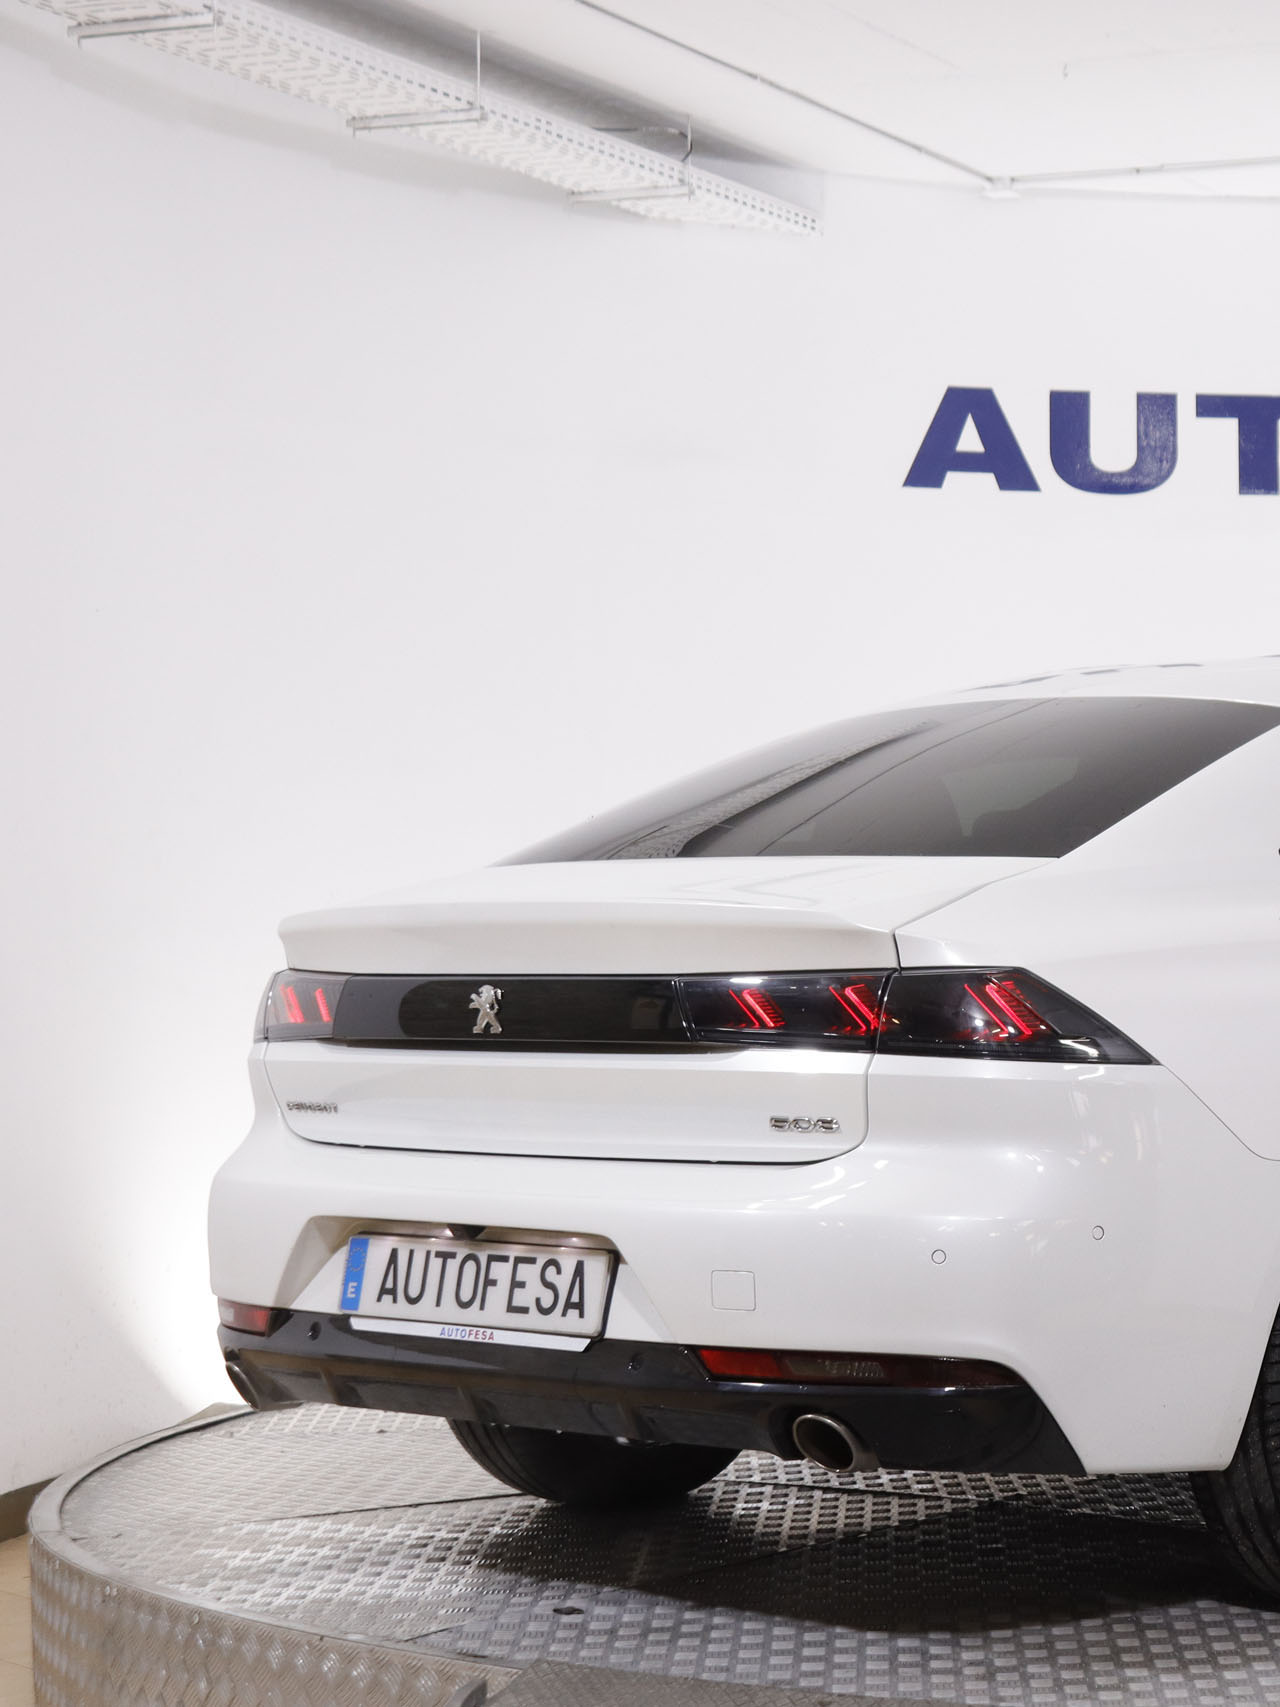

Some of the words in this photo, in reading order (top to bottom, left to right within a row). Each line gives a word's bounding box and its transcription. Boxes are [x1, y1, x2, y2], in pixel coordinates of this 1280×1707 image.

[346, 1282, 358, 1298] E
[376, 1248, 586, 1319] AUTOFESA
[439, 1327, 495, 1341] AUTOFESA
